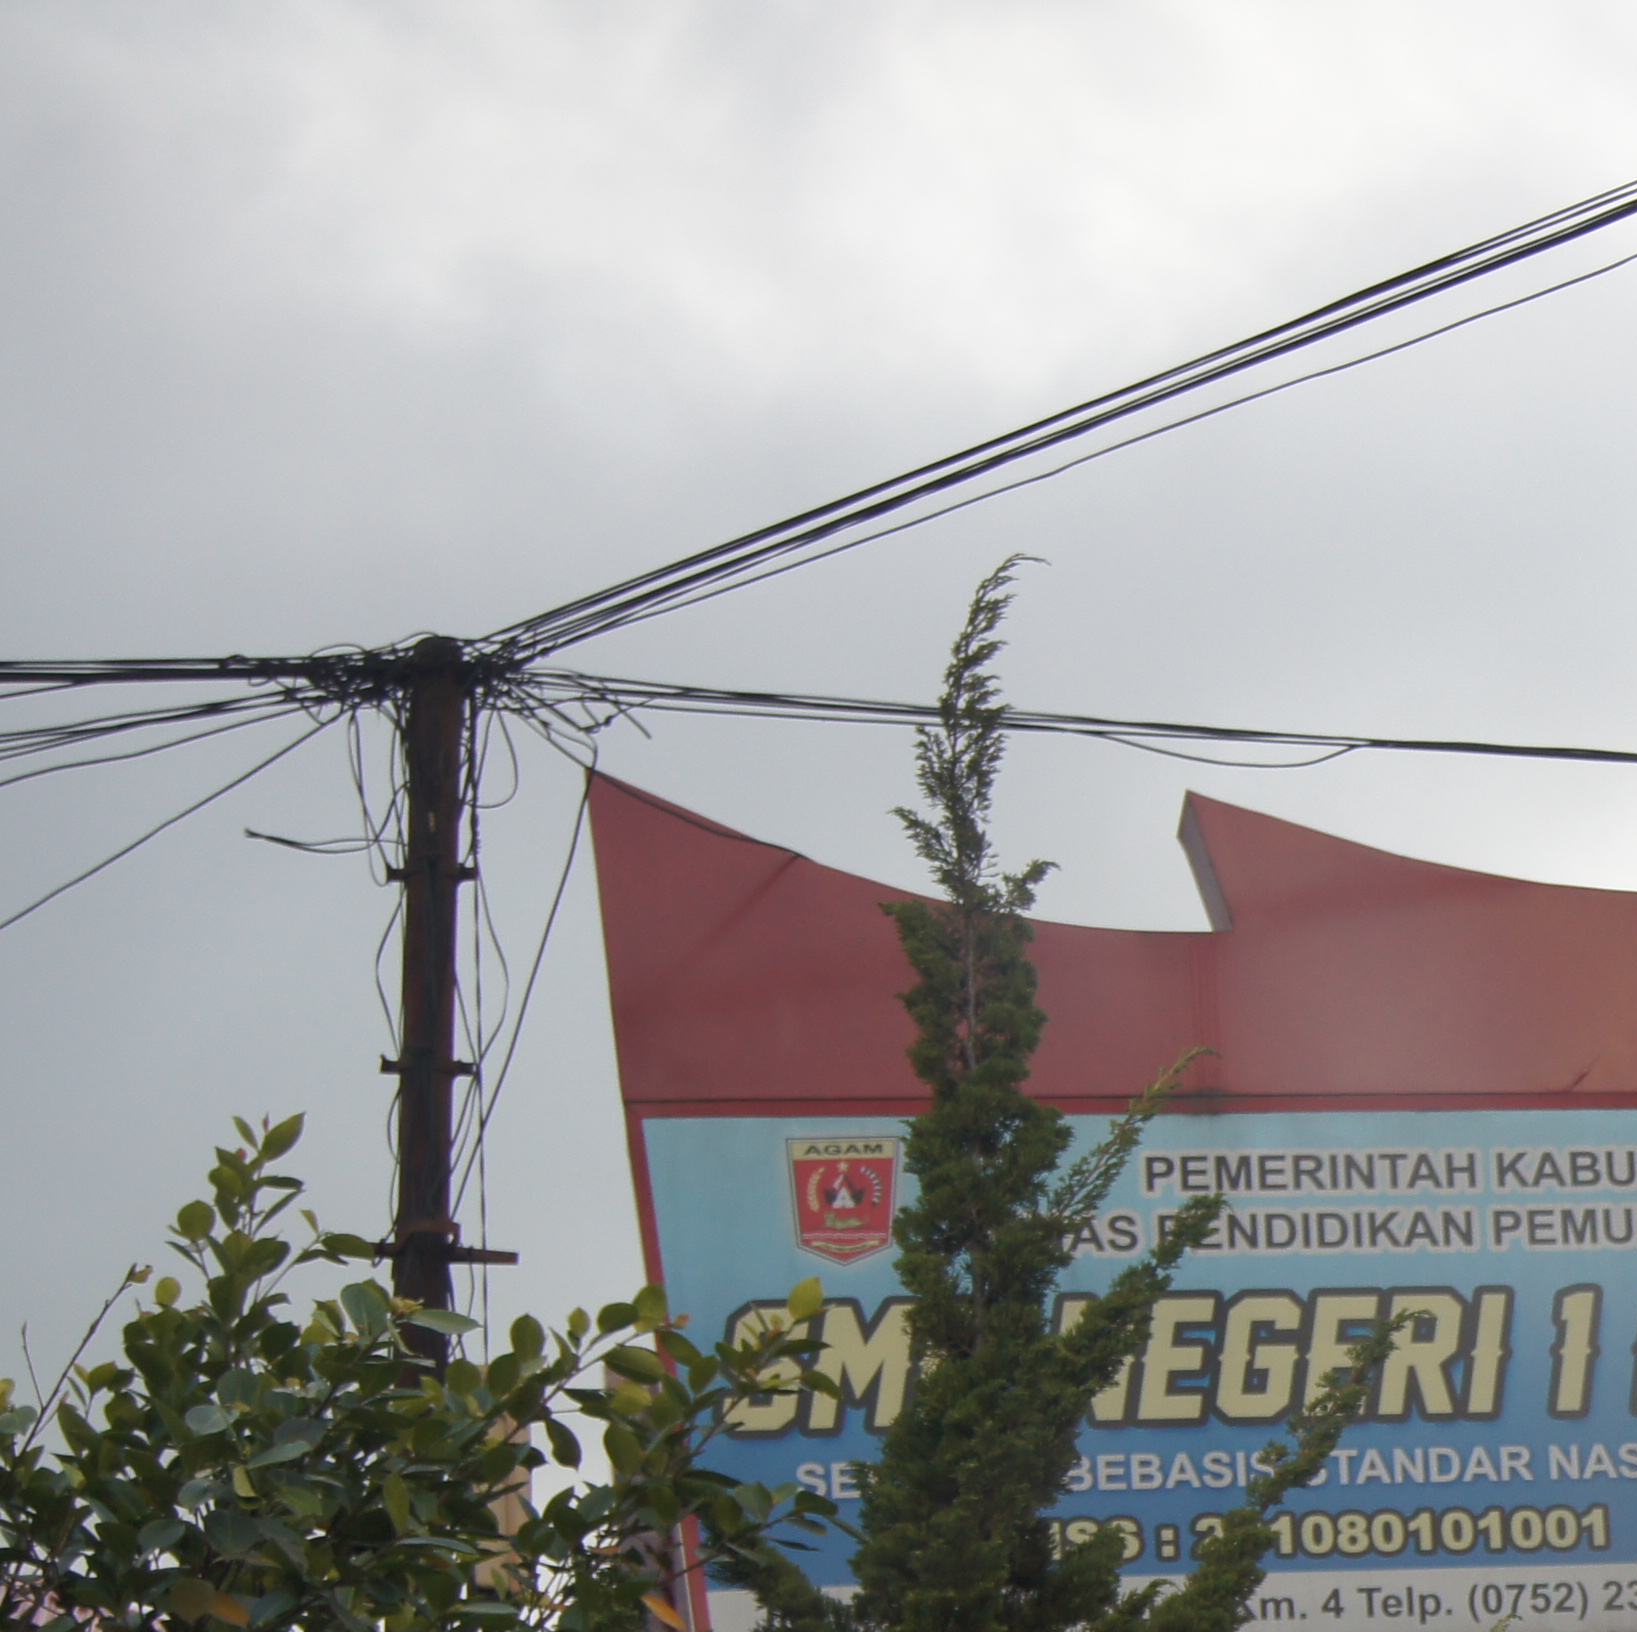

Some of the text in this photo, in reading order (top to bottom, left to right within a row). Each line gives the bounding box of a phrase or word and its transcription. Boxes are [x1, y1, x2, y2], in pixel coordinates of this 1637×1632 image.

[803, 1143, 885, 1157] AGAM
[1144, 1151, 1477, 1193] PEMERINTAH
[1548, 1284, 1602, 1419] 1
[1308, 1444, 1533, 1488] TANDAR
[1190, 1504, 1609, 1562] 21080101001
[1321, 1587, 1344, 1619] 4
[1357, 1586, 1453, 1624] Telp.
[1468, 1578, 1590, 1623] (0752)
